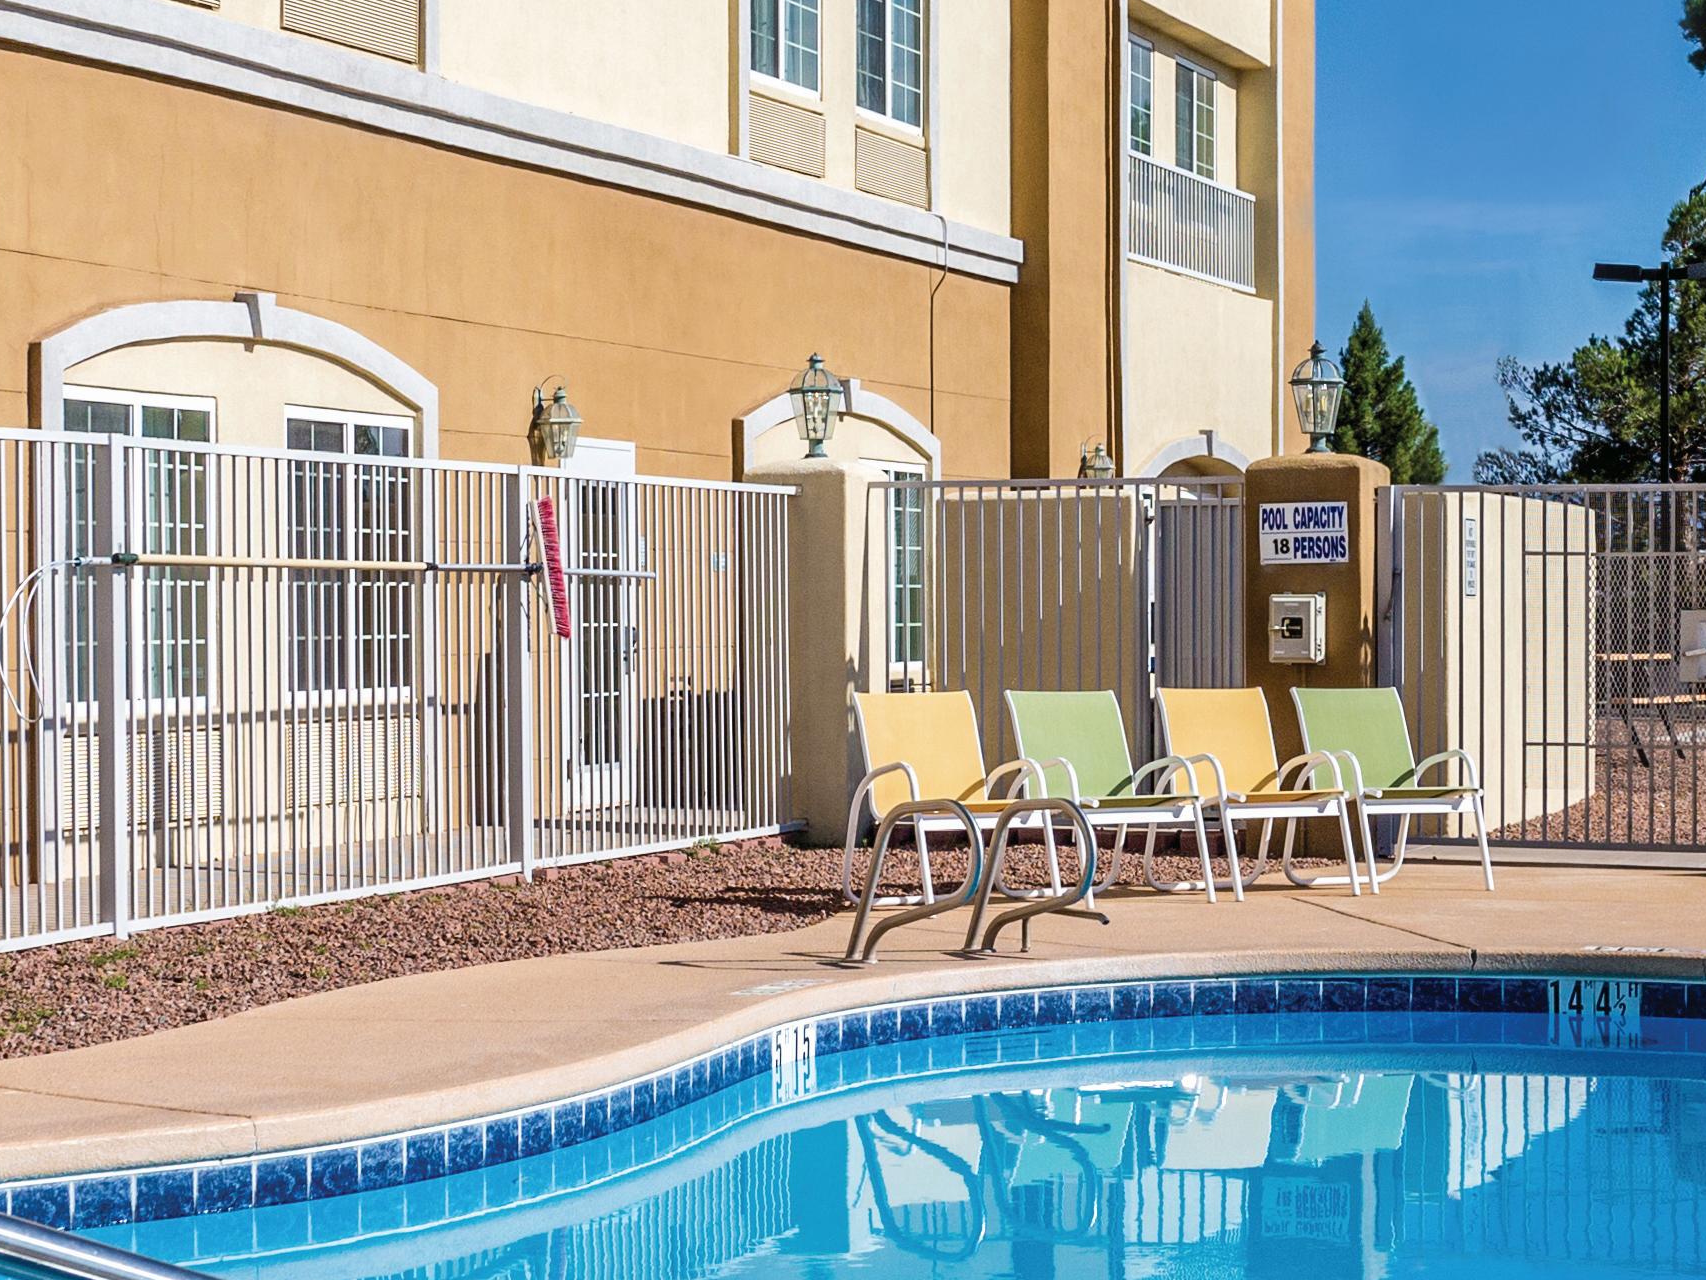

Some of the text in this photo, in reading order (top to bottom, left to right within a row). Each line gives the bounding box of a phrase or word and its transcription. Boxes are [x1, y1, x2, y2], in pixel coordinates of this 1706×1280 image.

[1262, 505, 1344, 530] POOL CAPACITY
[1272, 535, 1346, 559] 18 PERSONS
